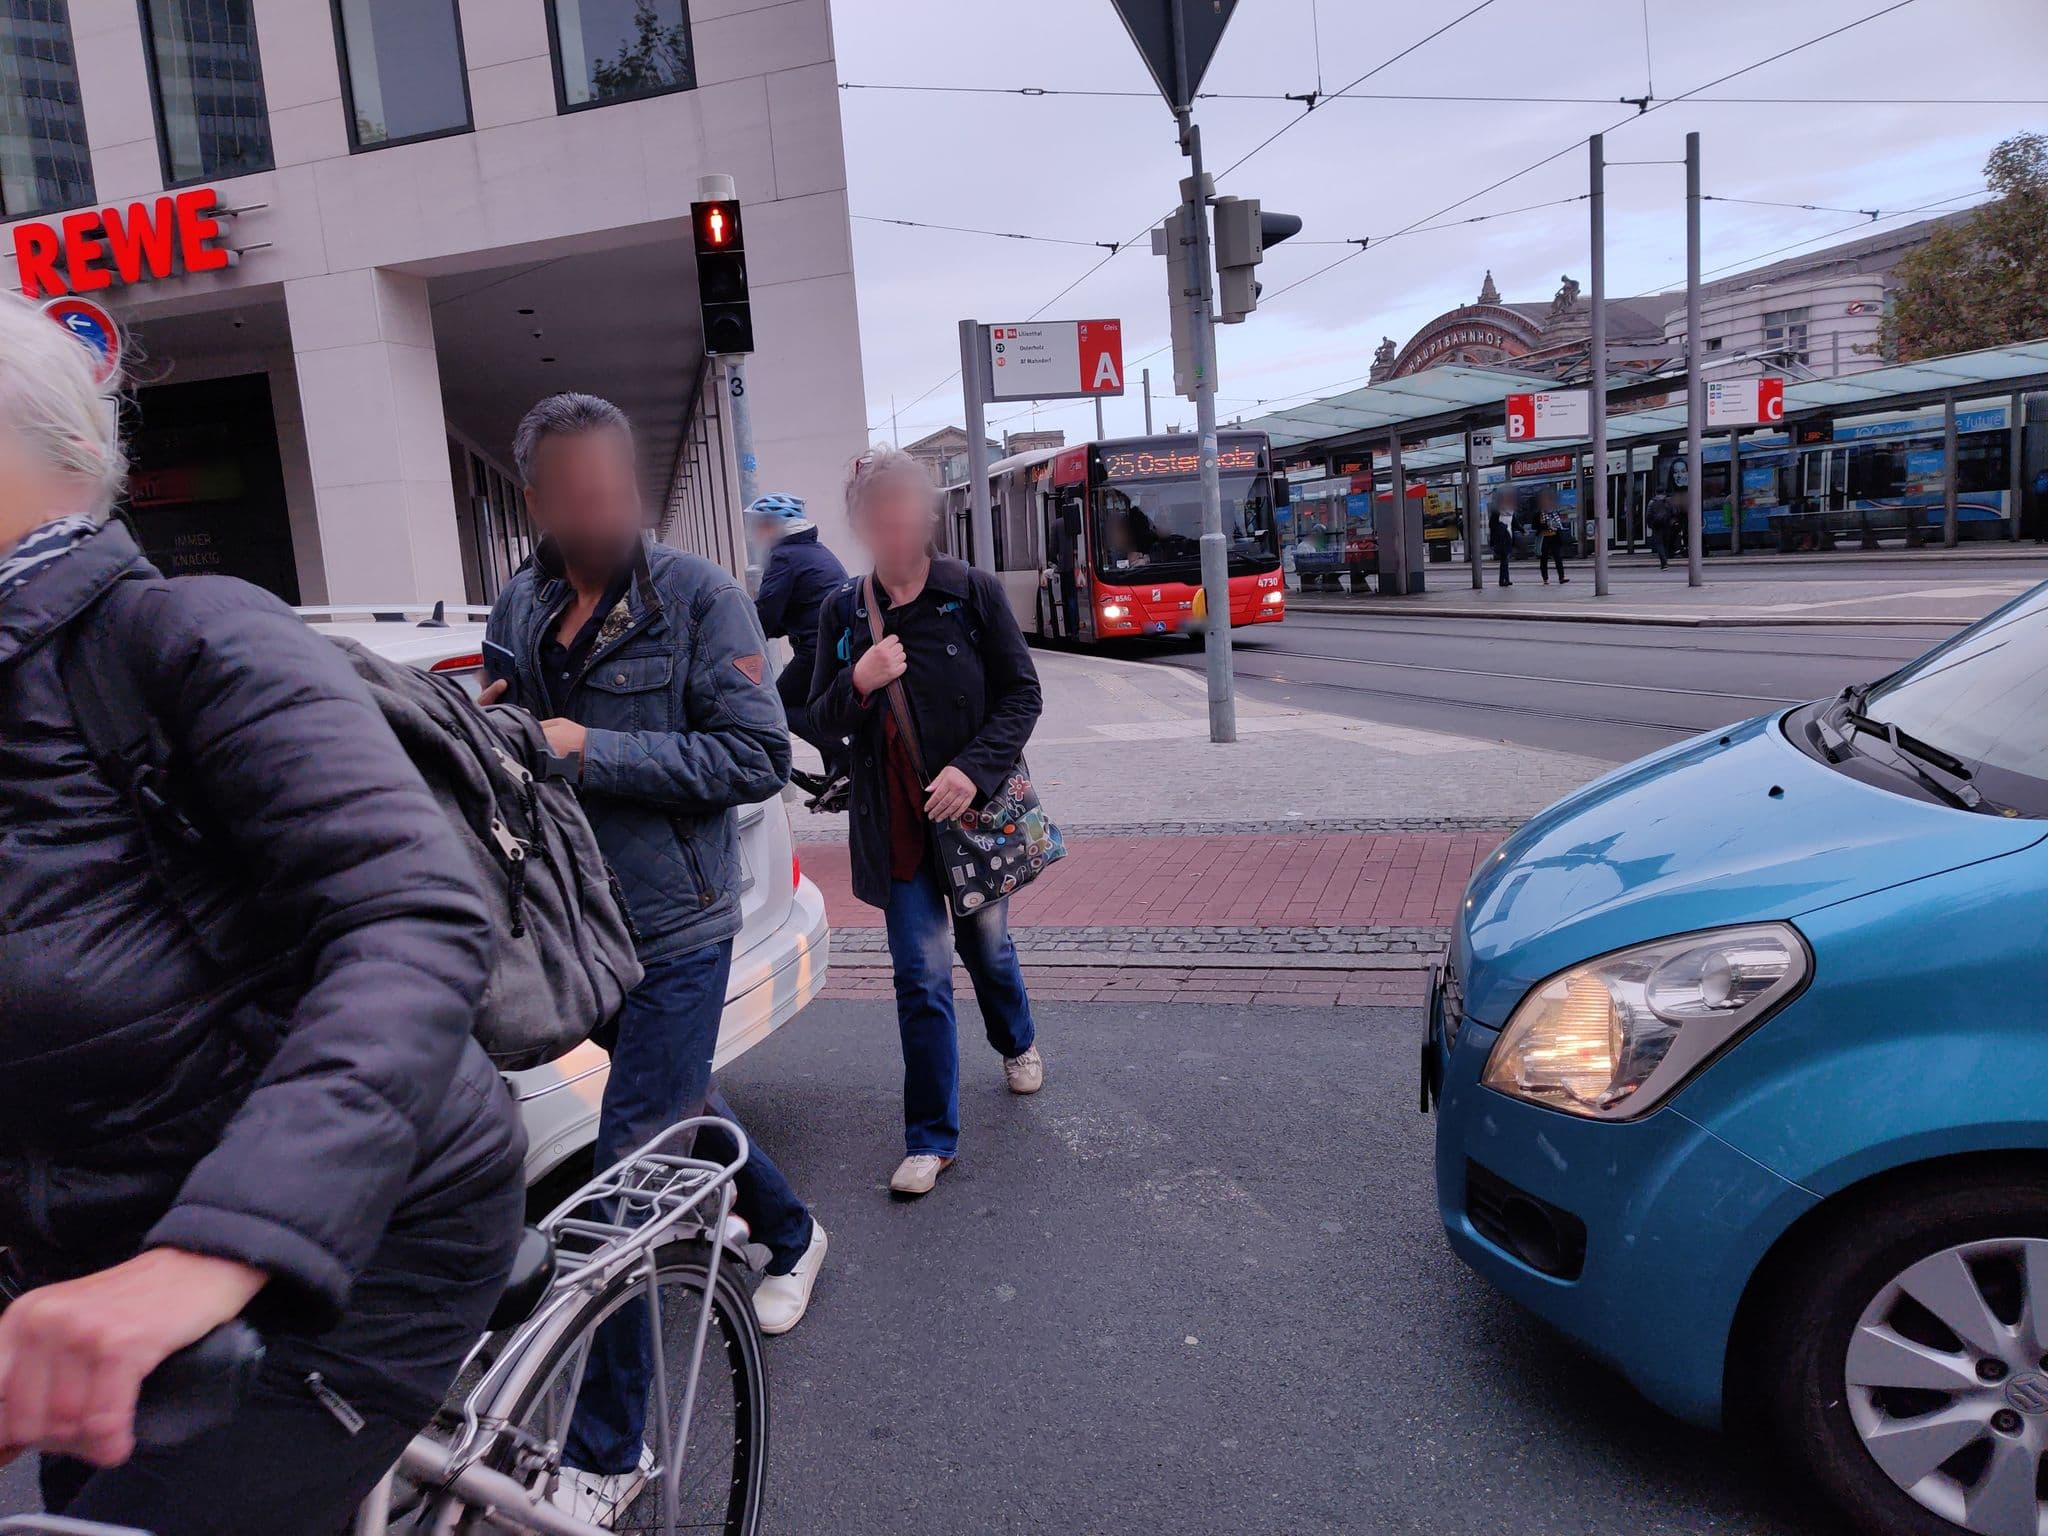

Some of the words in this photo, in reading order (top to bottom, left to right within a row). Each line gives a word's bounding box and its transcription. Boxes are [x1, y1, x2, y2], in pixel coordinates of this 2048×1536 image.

[13, 188, 229, 300] REWE
[1408, 330, 1504, 374] HAUPTBAHNHOF
[1093, 352, 1121, 388] A
[731, 376, 745, 397] 3
[1767, 396, 1782, 420] C
[1509, 414, 1526, 437] B
[1967, 412, 2002, 430] future
[1106, 453, 1135, 477] 25
[1137, 445, 1256, 475] Osterolz
[1522, 455, 1566, 473] Hauptbahnhof
[1257, 577, 1278, 588] 4730
